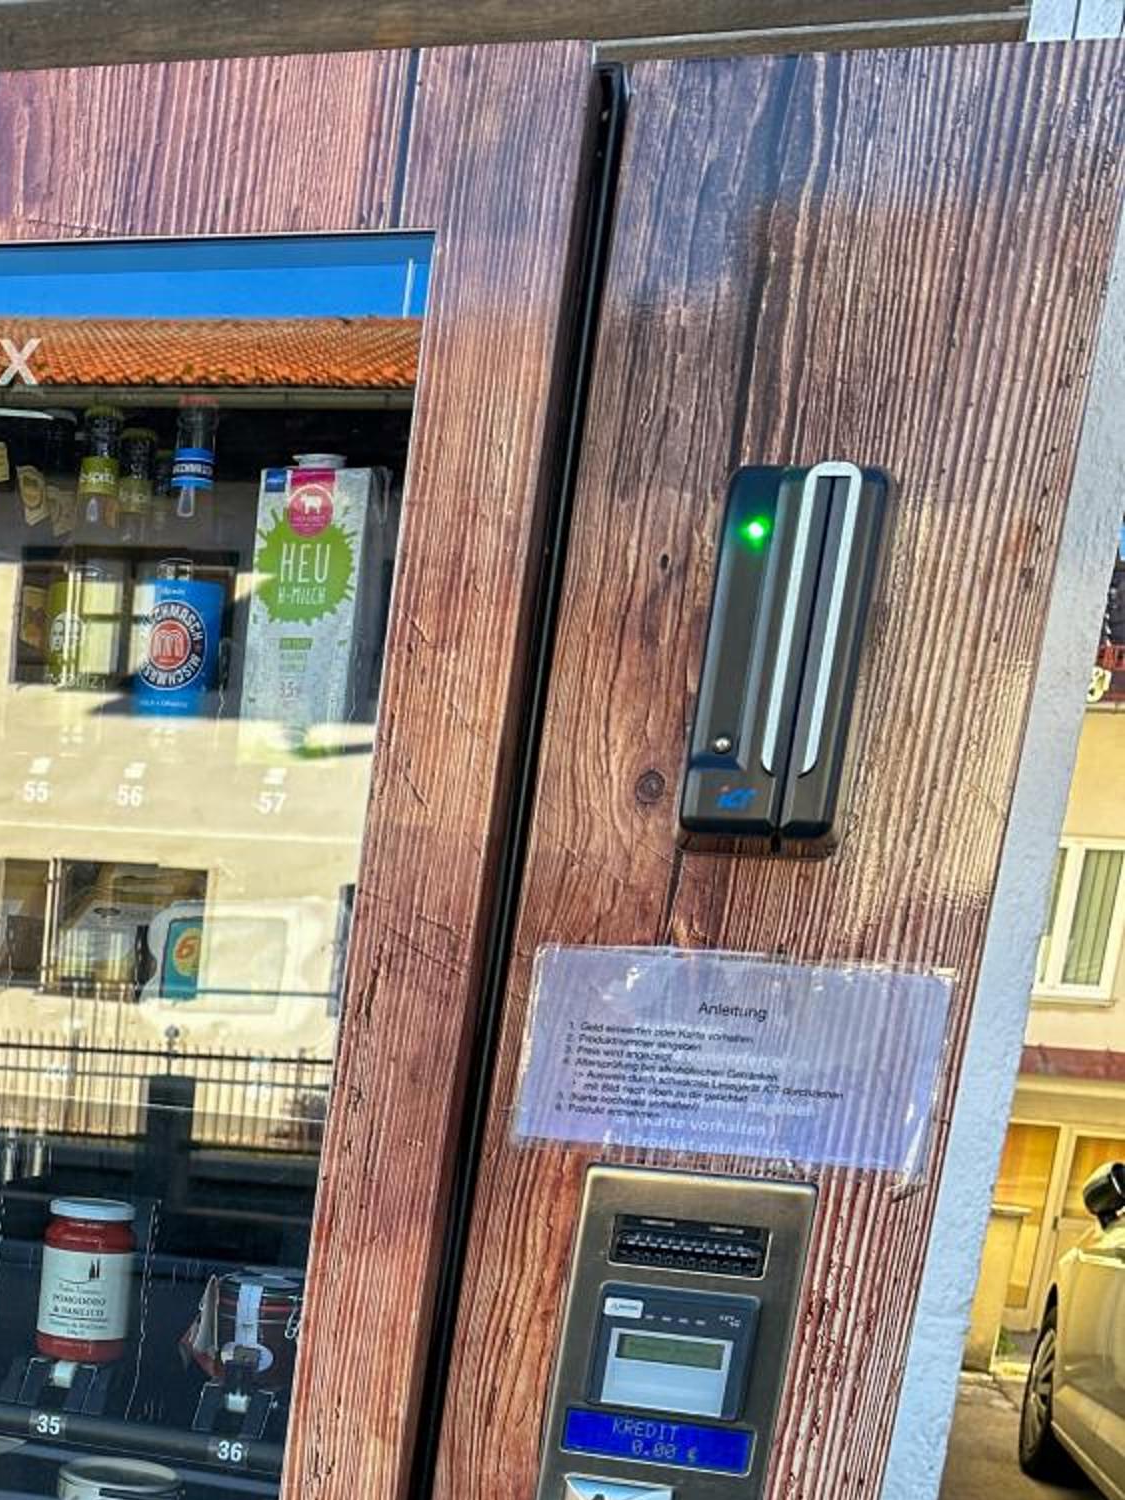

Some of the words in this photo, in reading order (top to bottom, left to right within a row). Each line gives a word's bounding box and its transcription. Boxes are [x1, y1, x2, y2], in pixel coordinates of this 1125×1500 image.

[280, 543, 331, 583] HEU
[25, 781, 49, 802] 55
[118, 786, 144, 807] 56
[259, 793, 285, 814] 57
[699, 1002, 768, 1022] Anleitung
[36, 1416, 60, 1435] 35
[612, 1417, 680, 1441] KREDIT
[218, 1442, 243, 1462] 36
[632, 1438, 677, 1459] 0.00
